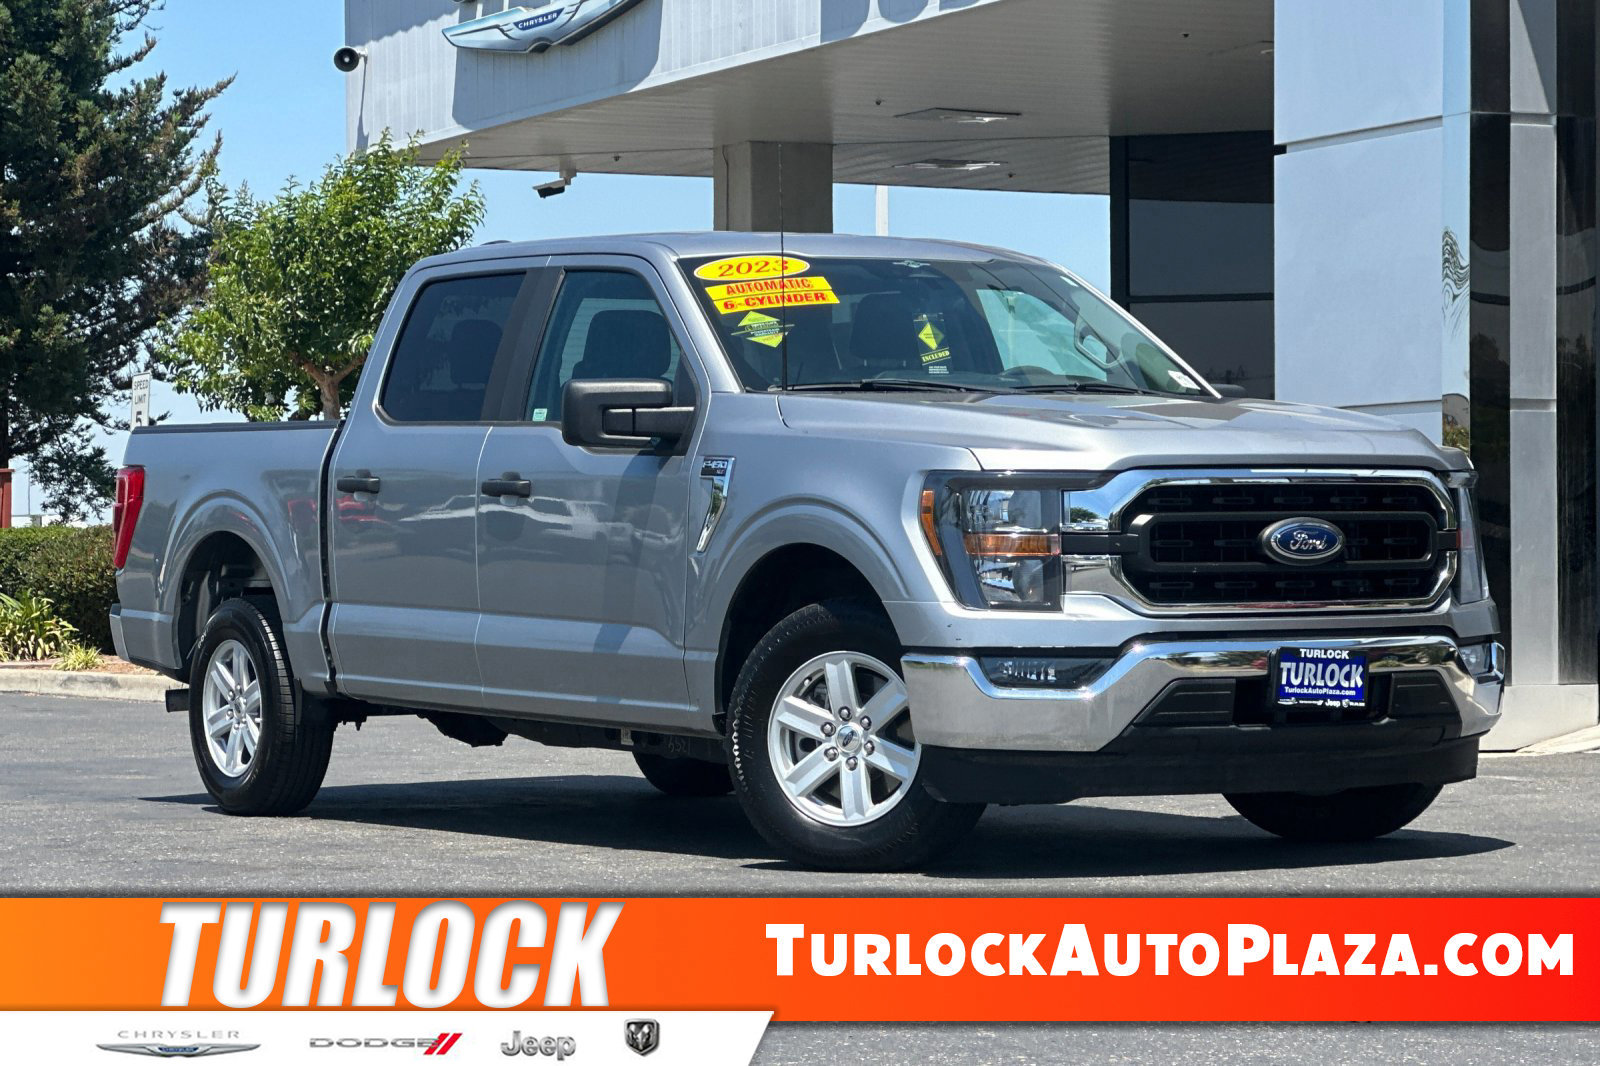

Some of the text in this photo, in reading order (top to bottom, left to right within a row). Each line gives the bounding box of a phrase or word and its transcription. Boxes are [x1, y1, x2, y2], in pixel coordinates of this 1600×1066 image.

[518, 13, 558, 29] CHRYSLER
[718, 260, 789, 277] 2023
[726, 278, 812, 295] AUTOMATIC
[723, 292, 826, 310] 6-CYLINDER
[921, 350, 950, 362] INCLUDED
[134, 380, 148, 390] SPEED
[135, 394, 146, 405] LIMIT
[1290, 530, 1328, 550] Ford
[1300, 648, 1350, 659] TURLOCK
[1280, 662, 1364, 688] TURLOCK
[1284, 686, 1356, 696] TurlockAutoPlaza.com
[1325, 699, 1341, 707] Jeep
